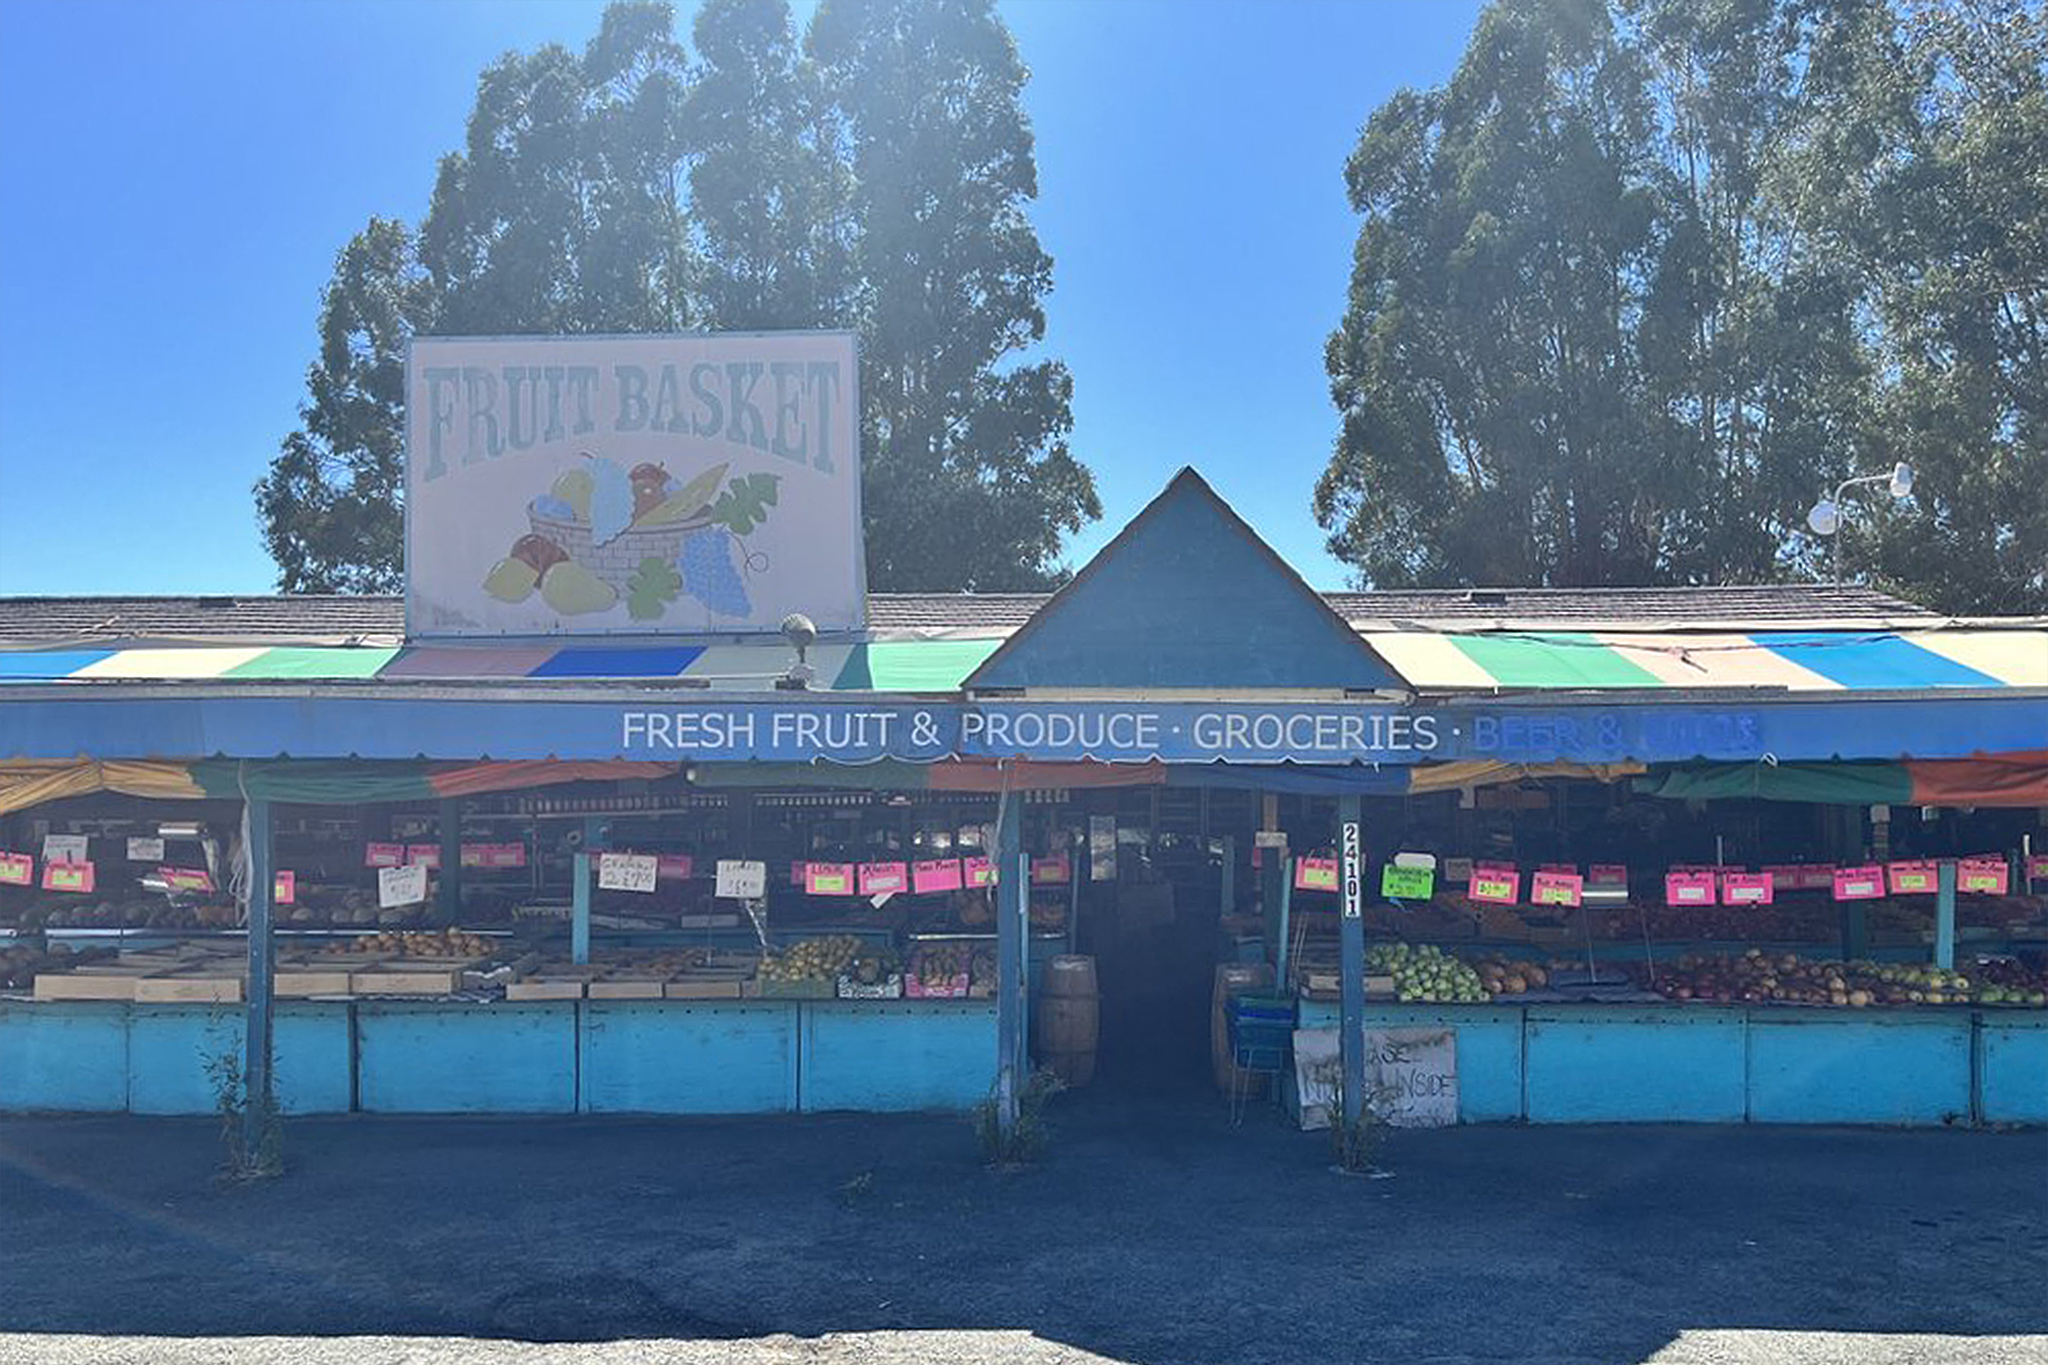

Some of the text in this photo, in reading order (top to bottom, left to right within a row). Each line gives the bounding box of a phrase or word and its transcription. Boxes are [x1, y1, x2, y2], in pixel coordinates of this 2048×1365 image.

[423, 360, 840, 482] FRUIT BASKET
[622, 712, 754, 748] FRESH
[772, 712, 897, 748] FRUIT
[910, 713, 941, 747] &
[962, 713, 1159, 749] PRODUCE
[1193, 713, 1438, 750] GROCERIES
[1474, 715, 1580, 750] BEER
[1345, 825, 1357, 915] 24101
